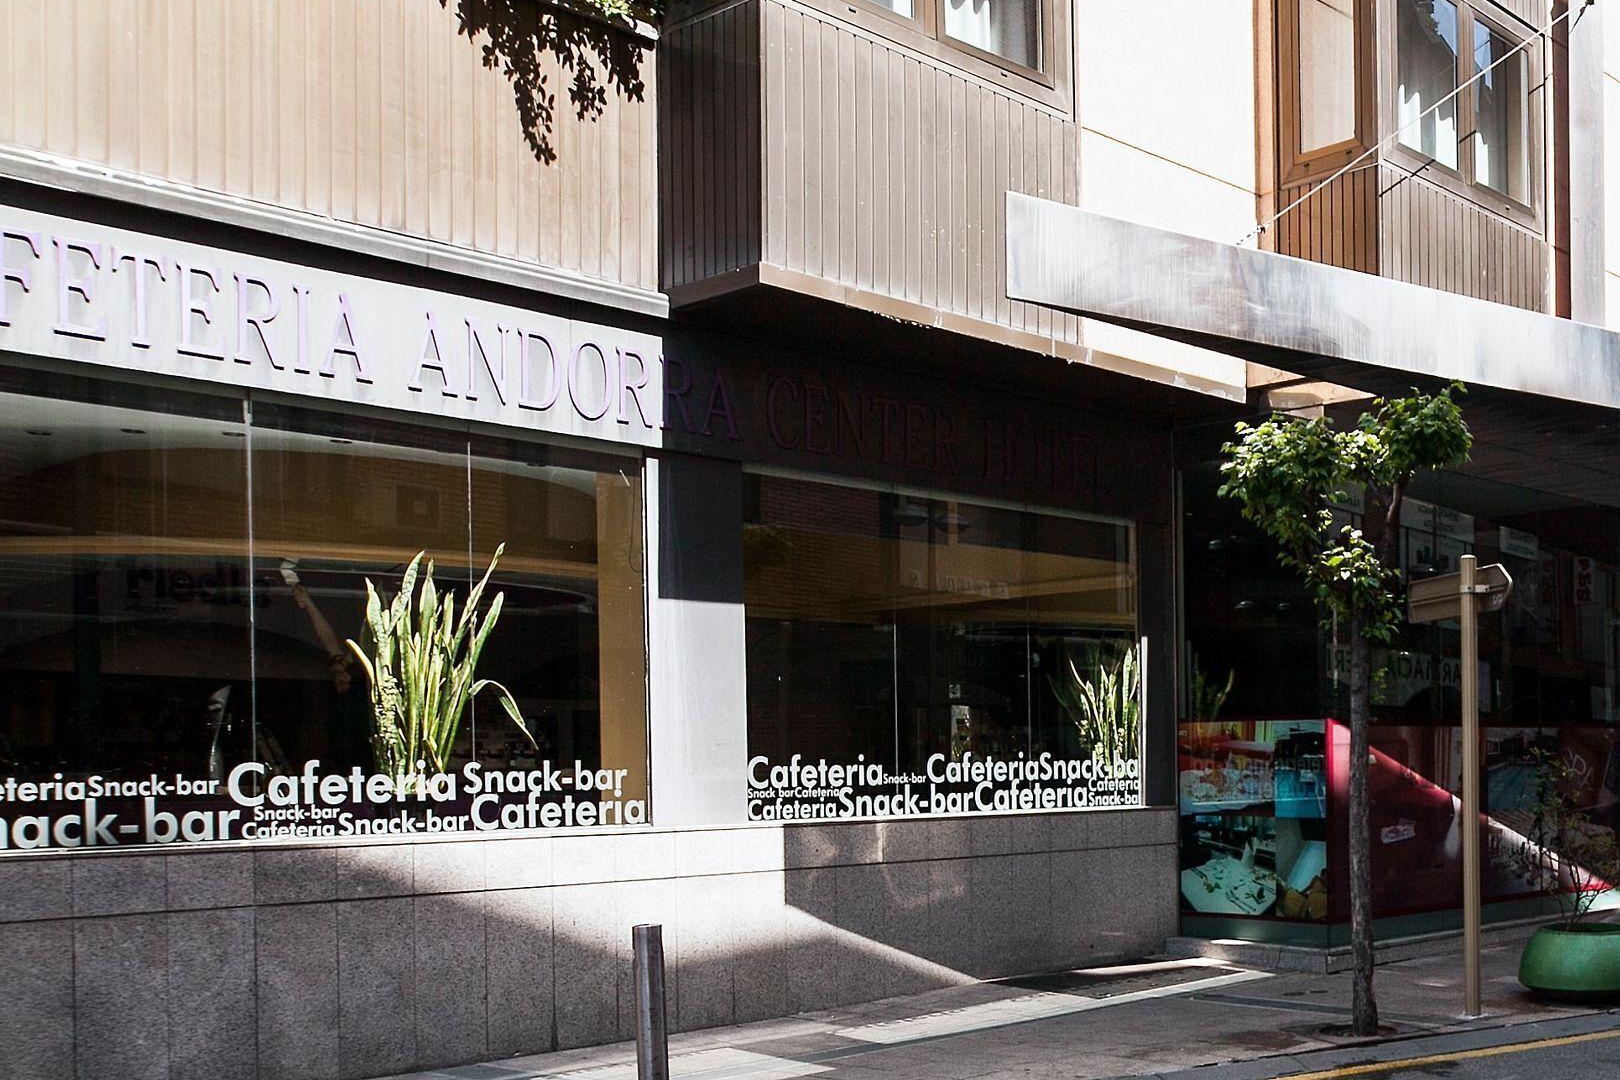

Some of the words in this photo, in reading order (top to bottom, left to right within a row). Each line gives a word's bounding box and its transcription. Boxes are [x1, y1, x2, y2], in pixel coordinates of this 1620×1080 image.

[408, 310, 738, 443] ANDORRA
[767, 376, 960, 474] CENTER
[88, 774, 220, 797] Snack-bar
[228, 759, 457, 807] Cafeteria
[463, 760, 628, 794] Snack-bar
[748, 754, 882, 789] Cafeteria
[883, 773, 927, 784] Snack-bar
[927, 751, 1039, 783] Cafeteria
[748, 797, 837, 820] Cafeteria
[838, 783, 974, 817] Snack-bar
[974, 778, 1088, 812] Cafeteria
[794, 786, 839, 798] Cafeteria
[241, 821, 335, 840] Cafeteria
[338, 809, 469, 837] Snack-bar
[470, 790, 646, 831] Cafeteria
[254, 805, 341, 821] Snack-bar
